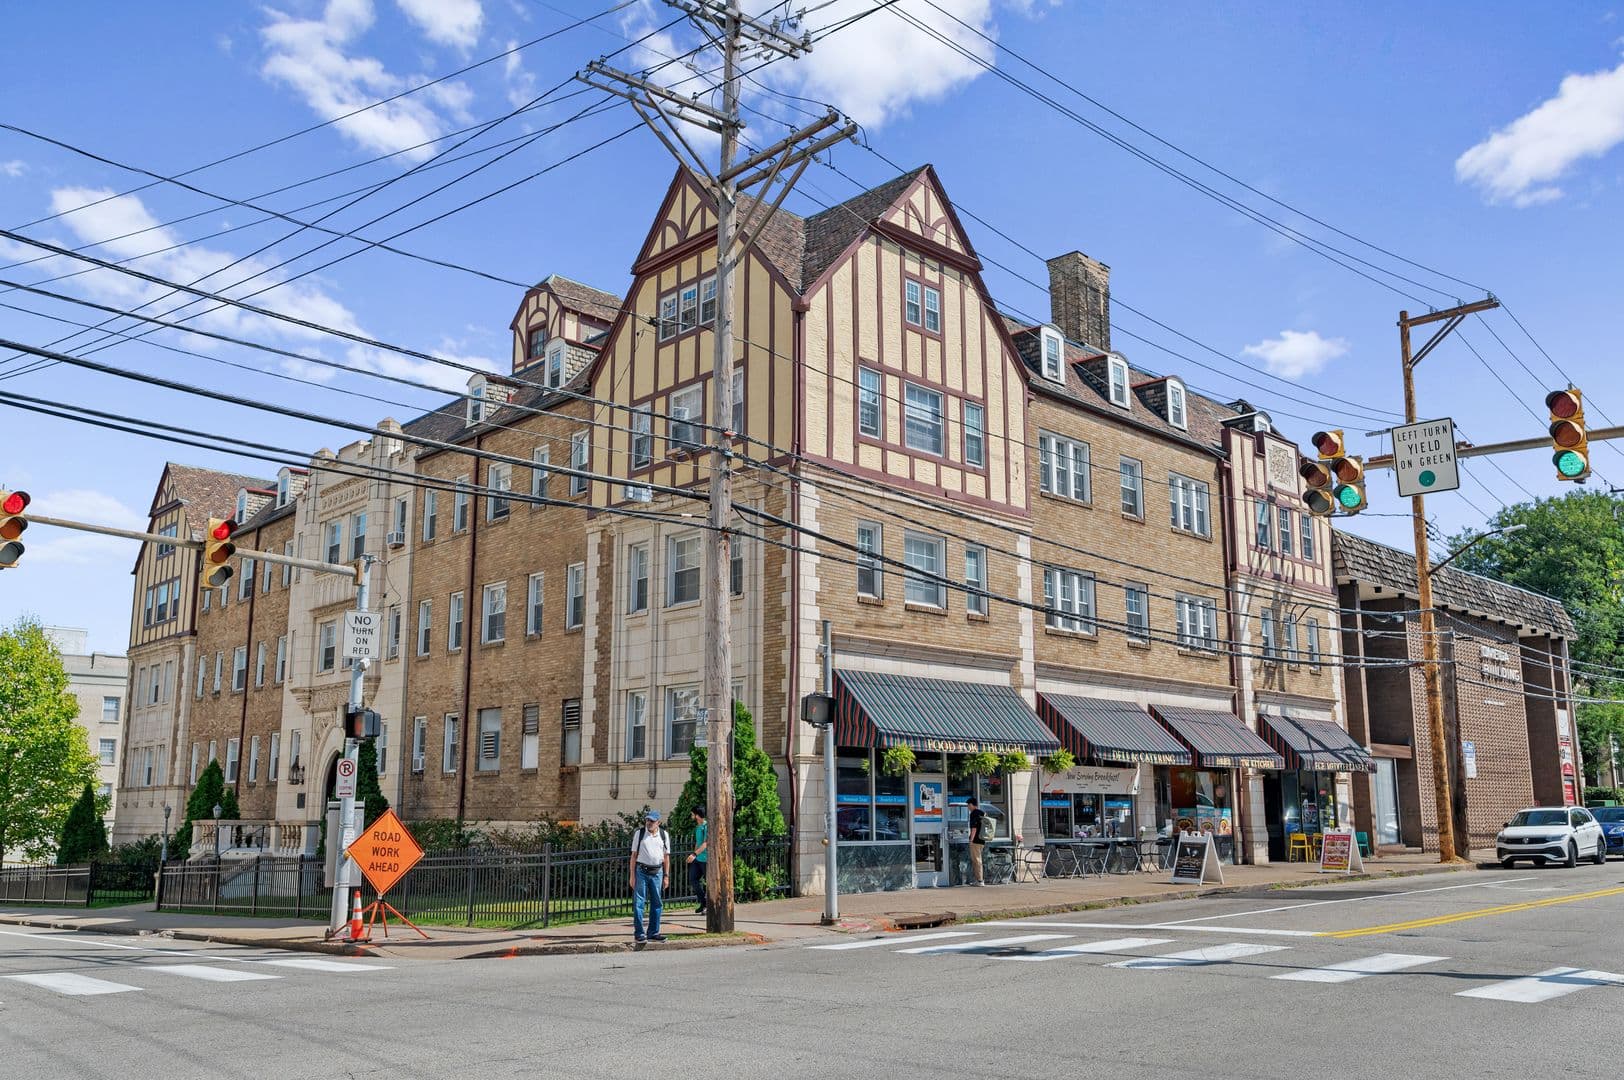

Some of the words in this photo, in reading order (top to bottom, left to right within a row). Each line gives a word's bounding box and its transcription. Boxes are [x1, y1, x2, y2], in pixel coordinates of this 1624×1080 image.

[1397, 430, 1418, 442] LEFT
[1423, 424, 1448, 438] TURN
[1407, 439, 1441, 455] YIELD
[1400, 459, 1413, 470] ON
[1419, 453, 1451, 467] GREEN
[354, 615, 372, 626] NO
[352, 626, 374, 636] TURN
[355, 636, 369, 645] ON
[352, 646, 370, 655] RED
[1481, 663, 1520, 681] BUILDING
[927, 738, 956, 752] FOOD
[958, 741, 978, 753] FOR
[980, 741, 1027, 755] THOUGHT
[1139, 752, 1176, 765] CATERING
[1250, 758, 1275, 769] KITCHEN
[373, 831, 401, 842] ROAD
[372, 846, 399, 858] WORK
[368, 862, 399, 873] AHEAD
